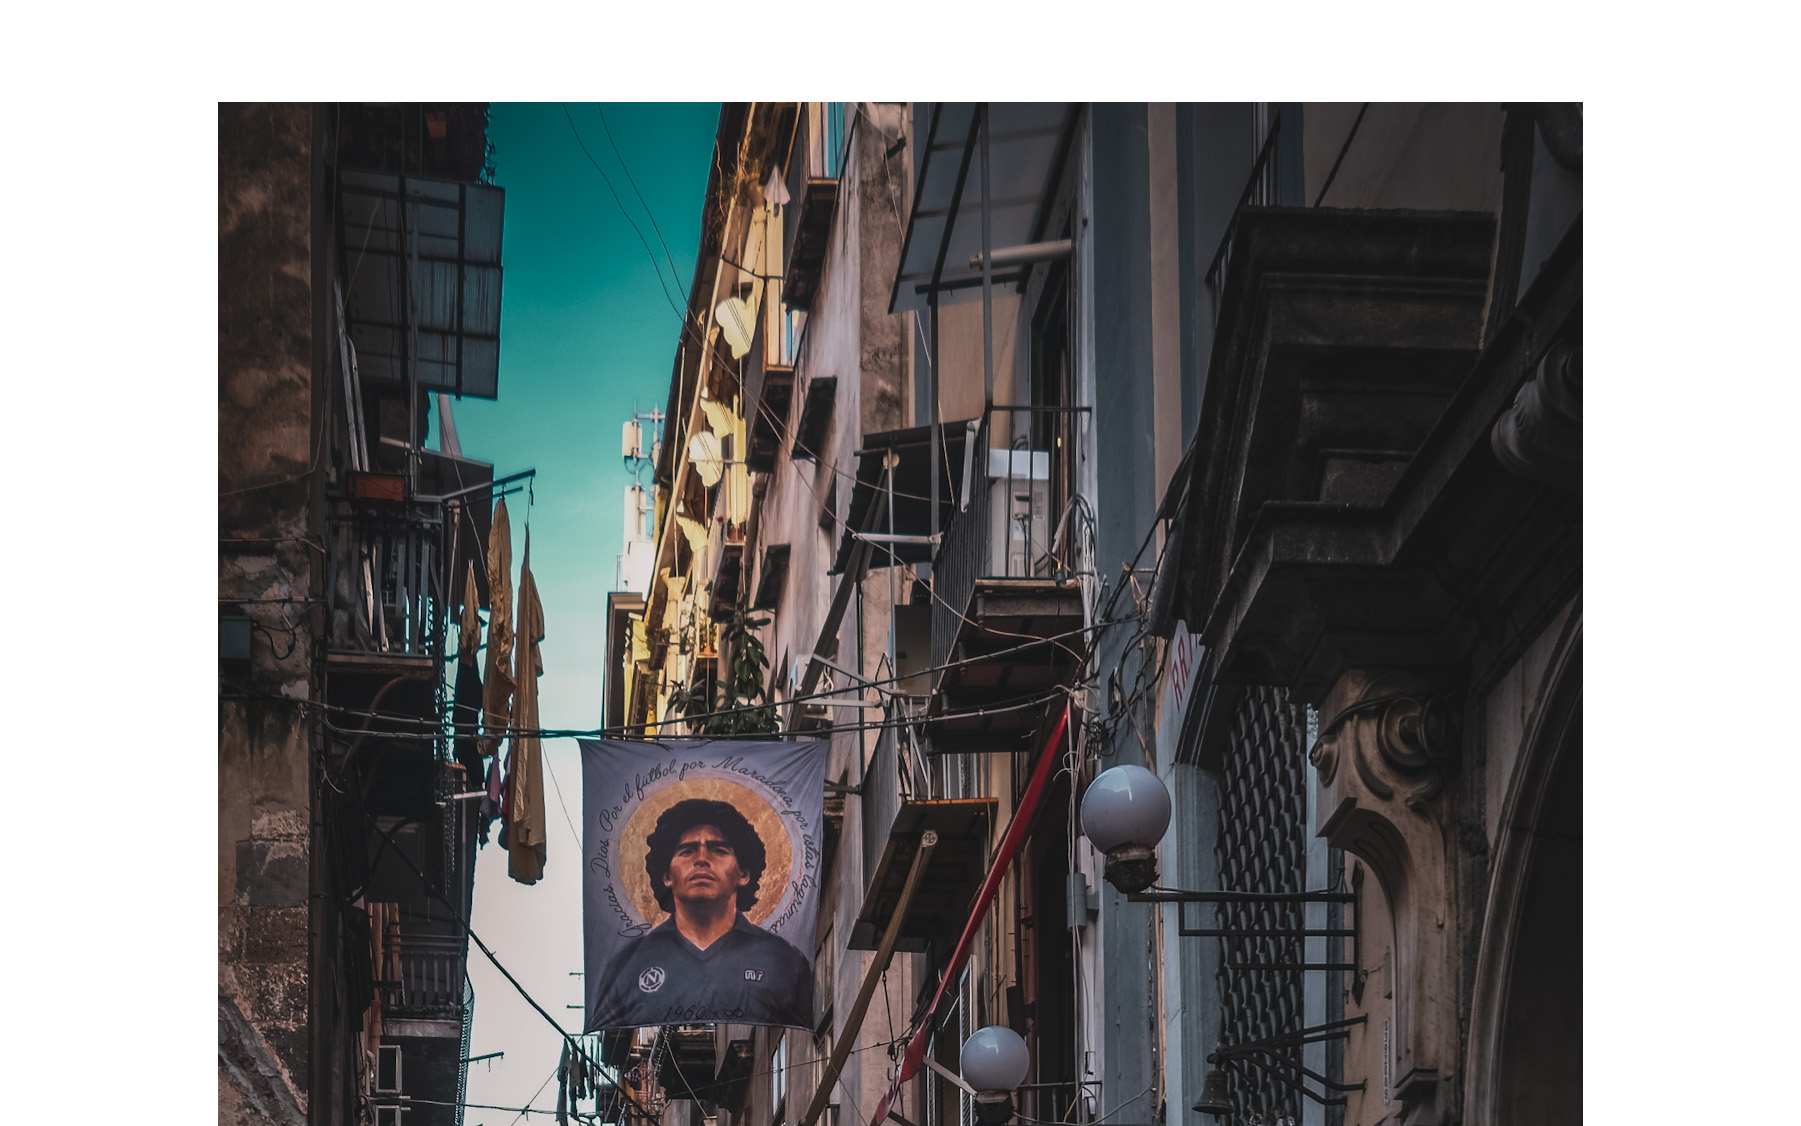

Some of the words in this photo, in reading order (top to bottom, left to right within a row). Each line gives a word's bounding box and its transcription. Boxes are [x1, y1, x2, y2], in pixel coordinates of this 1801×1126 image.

[599, 808, 622, 832] Por
[622, 782, 634, 803] el
[679, 760, 706, 781] por
[780, 810, 808, 831] por
[802, 833, 821, 871] estas
